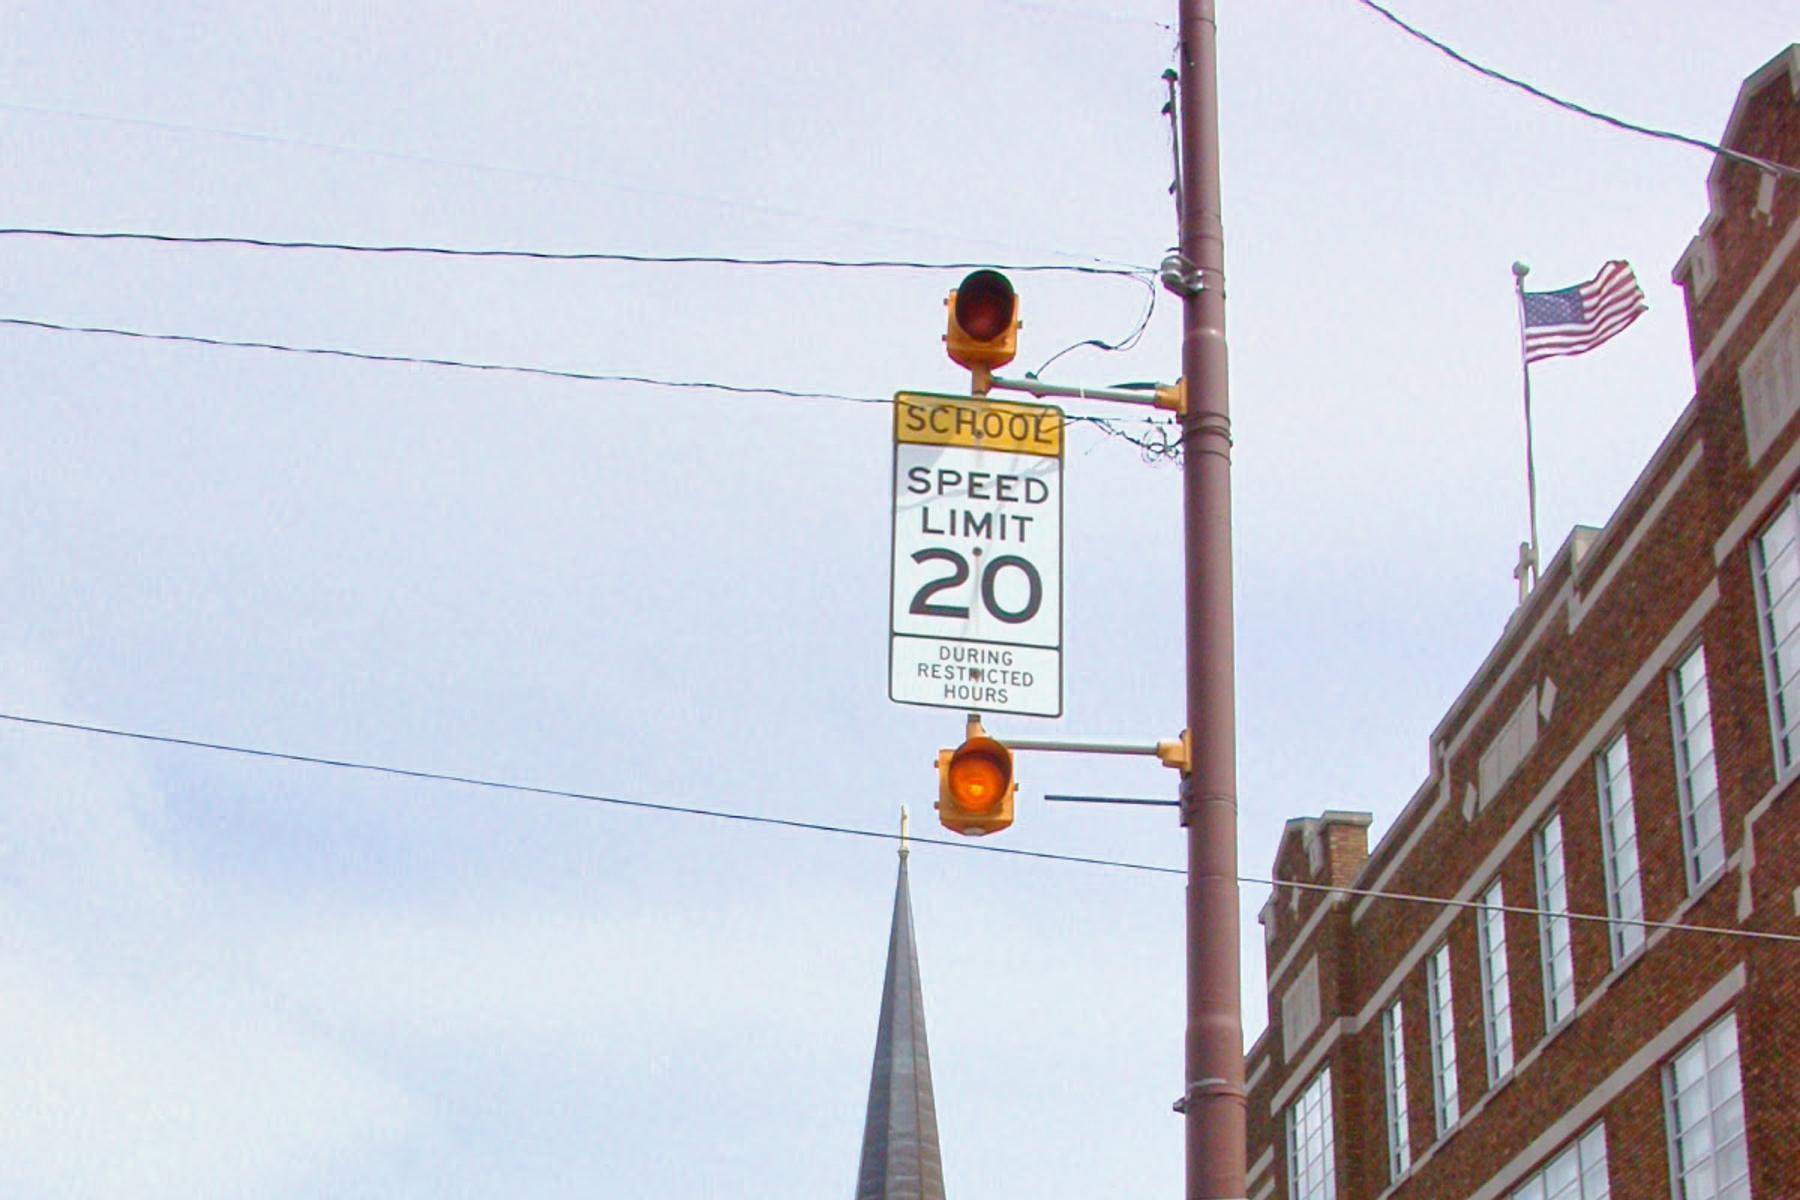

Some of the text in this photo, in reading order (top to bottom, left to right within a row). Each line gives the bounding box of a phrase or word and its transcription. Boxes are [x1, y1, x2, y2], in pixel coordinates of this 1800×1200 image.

[906, 404, 1053, 444] SCHOOL
[907, 466, 1050, 505] SPEED
[922, 506, 1034, 543] LIMIT
[908, 547, 1043, 625] 20
[939, 645, 1013, 667] DURING
[917, 662, 1034, 688] RESTRICTED
[944, 683, 1008, 704] HOURS
